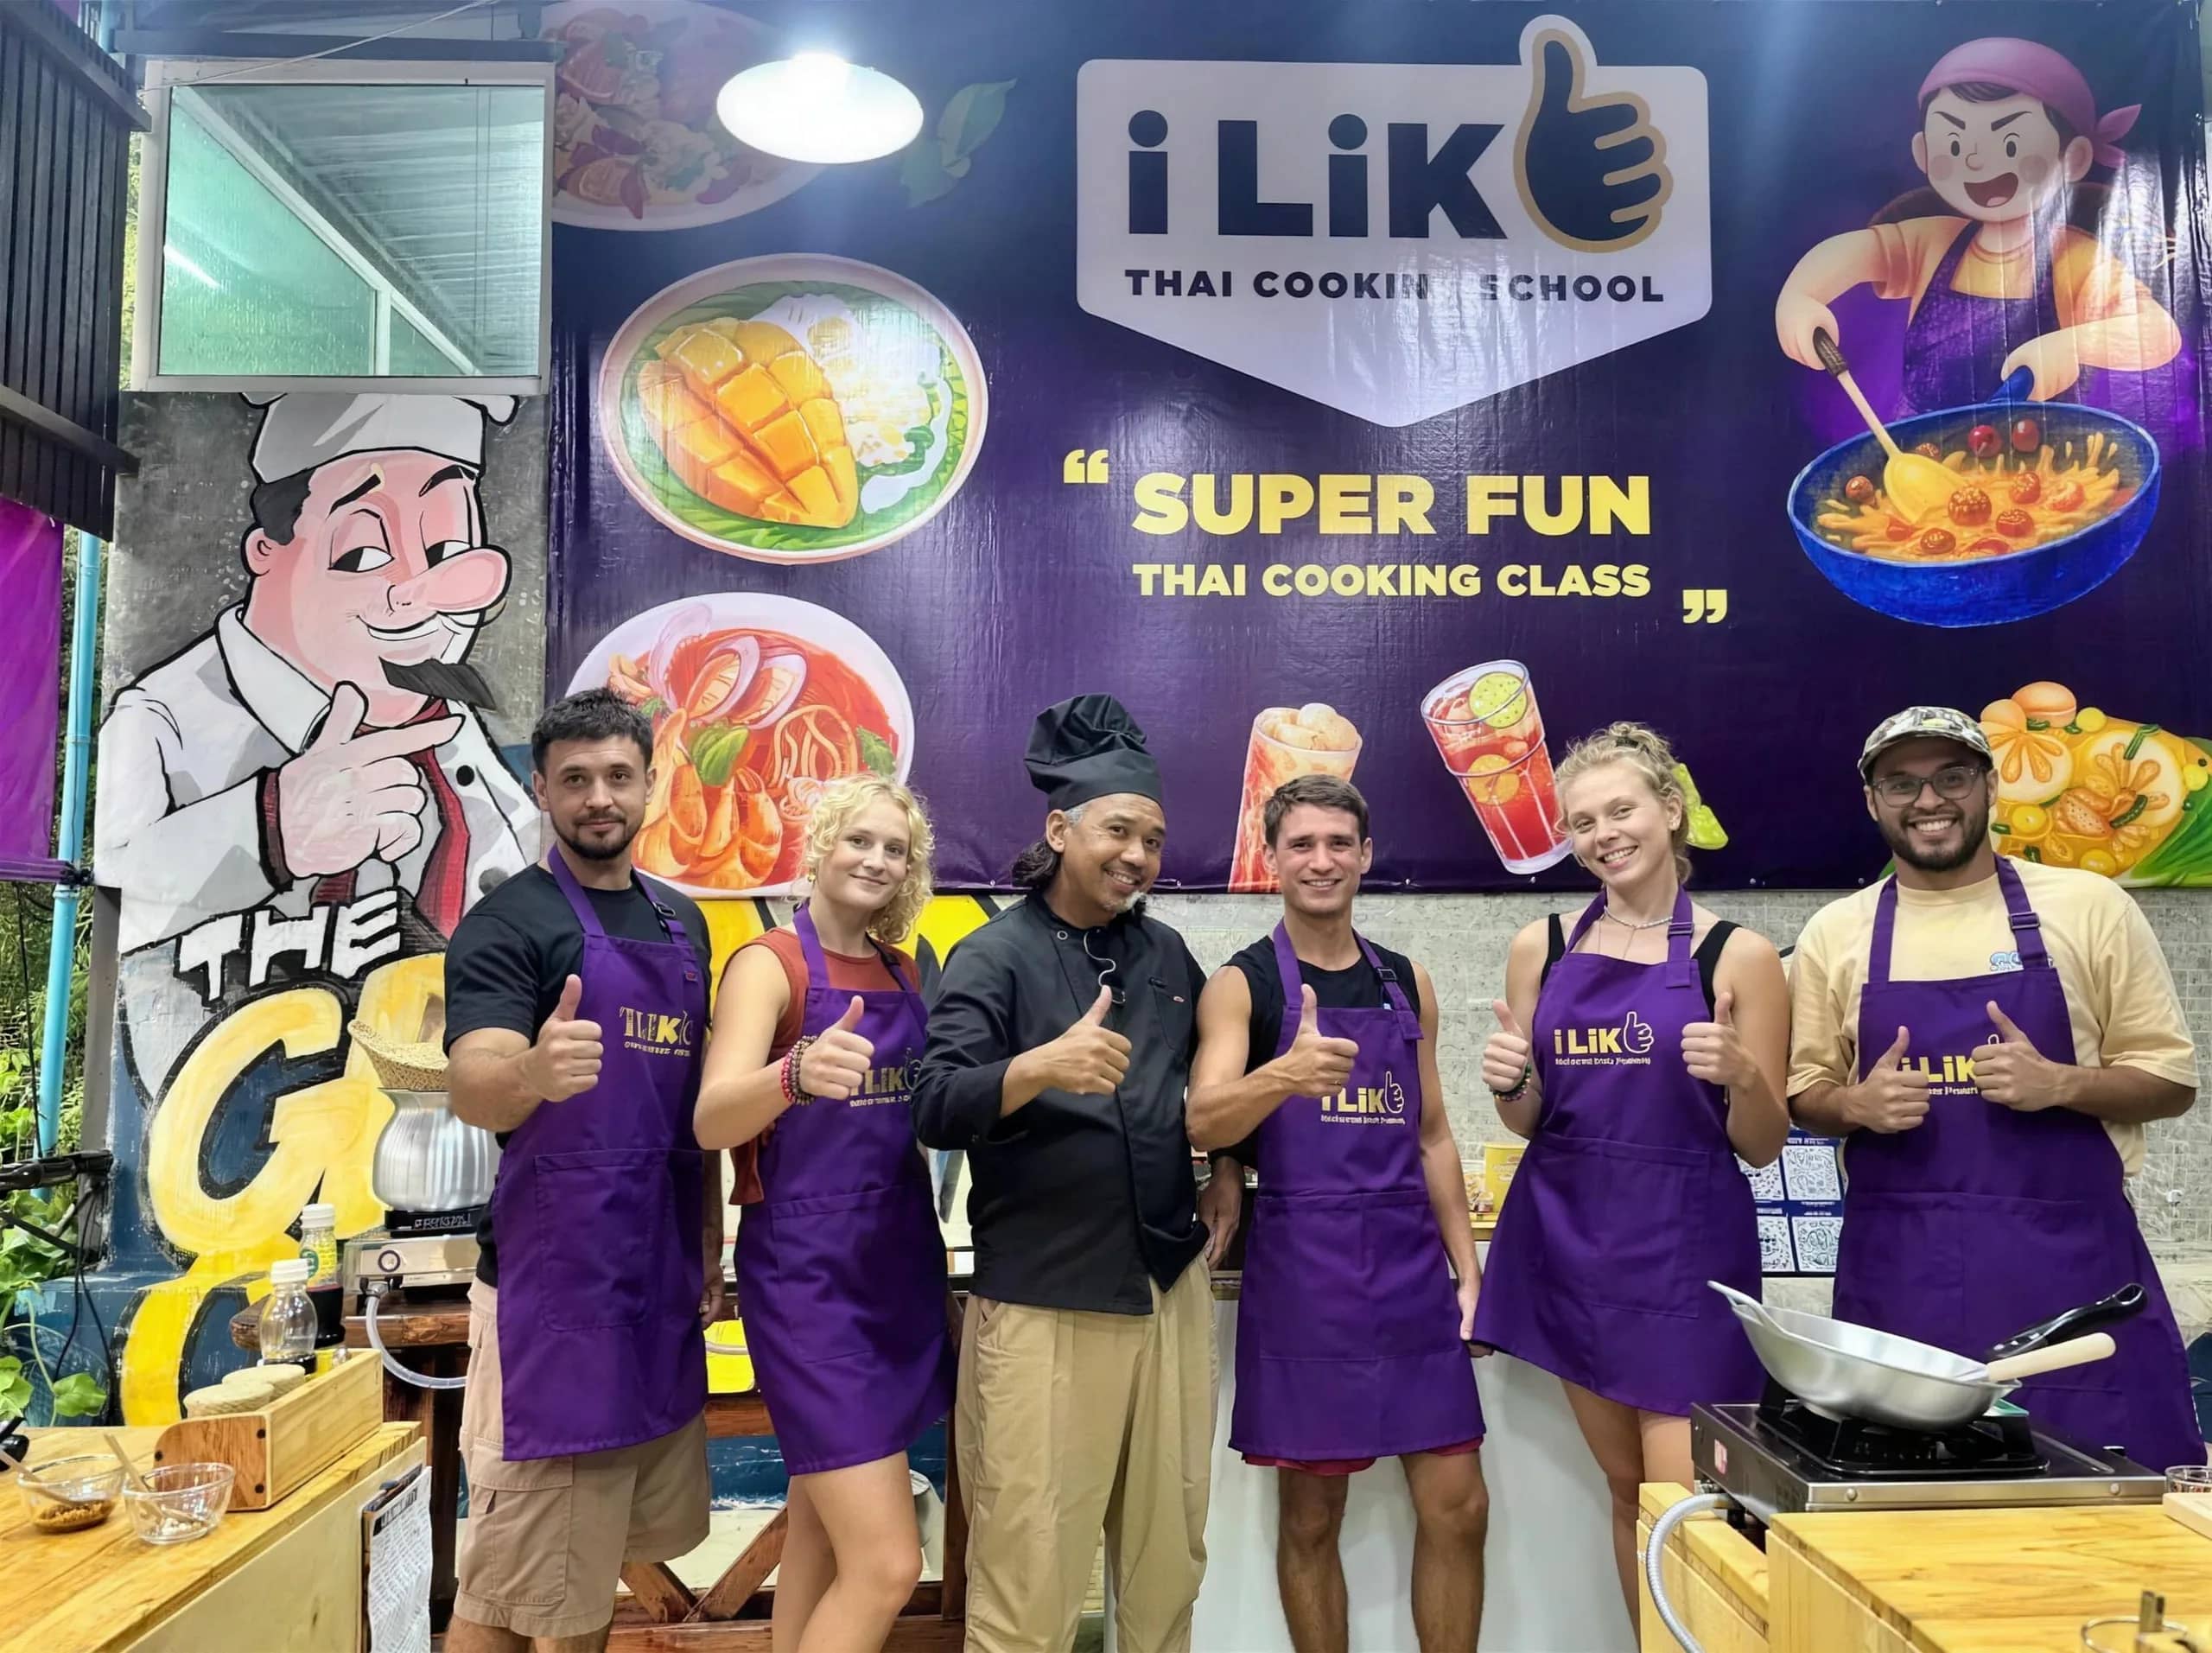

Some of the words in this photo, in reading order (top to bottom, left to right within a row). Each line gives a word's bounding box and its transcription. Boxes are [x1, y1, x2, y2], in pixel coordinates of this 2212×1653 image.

[1125, 269, 1232, 297] THAI
[1253, 270, 1460, 301] COOKIN
[1480, 273, 1664, 302] SCHOOL
[1132, 472, 1437, 536] SUPER
[1466, 475, 1651, 536] FUN
[1133, 563, 1246, 597] THAI
[1262, 563, 1481, 597] COOKING
[1497, 563, 1651, 598] CLASS
[177, 888, 402, 1001] THE
